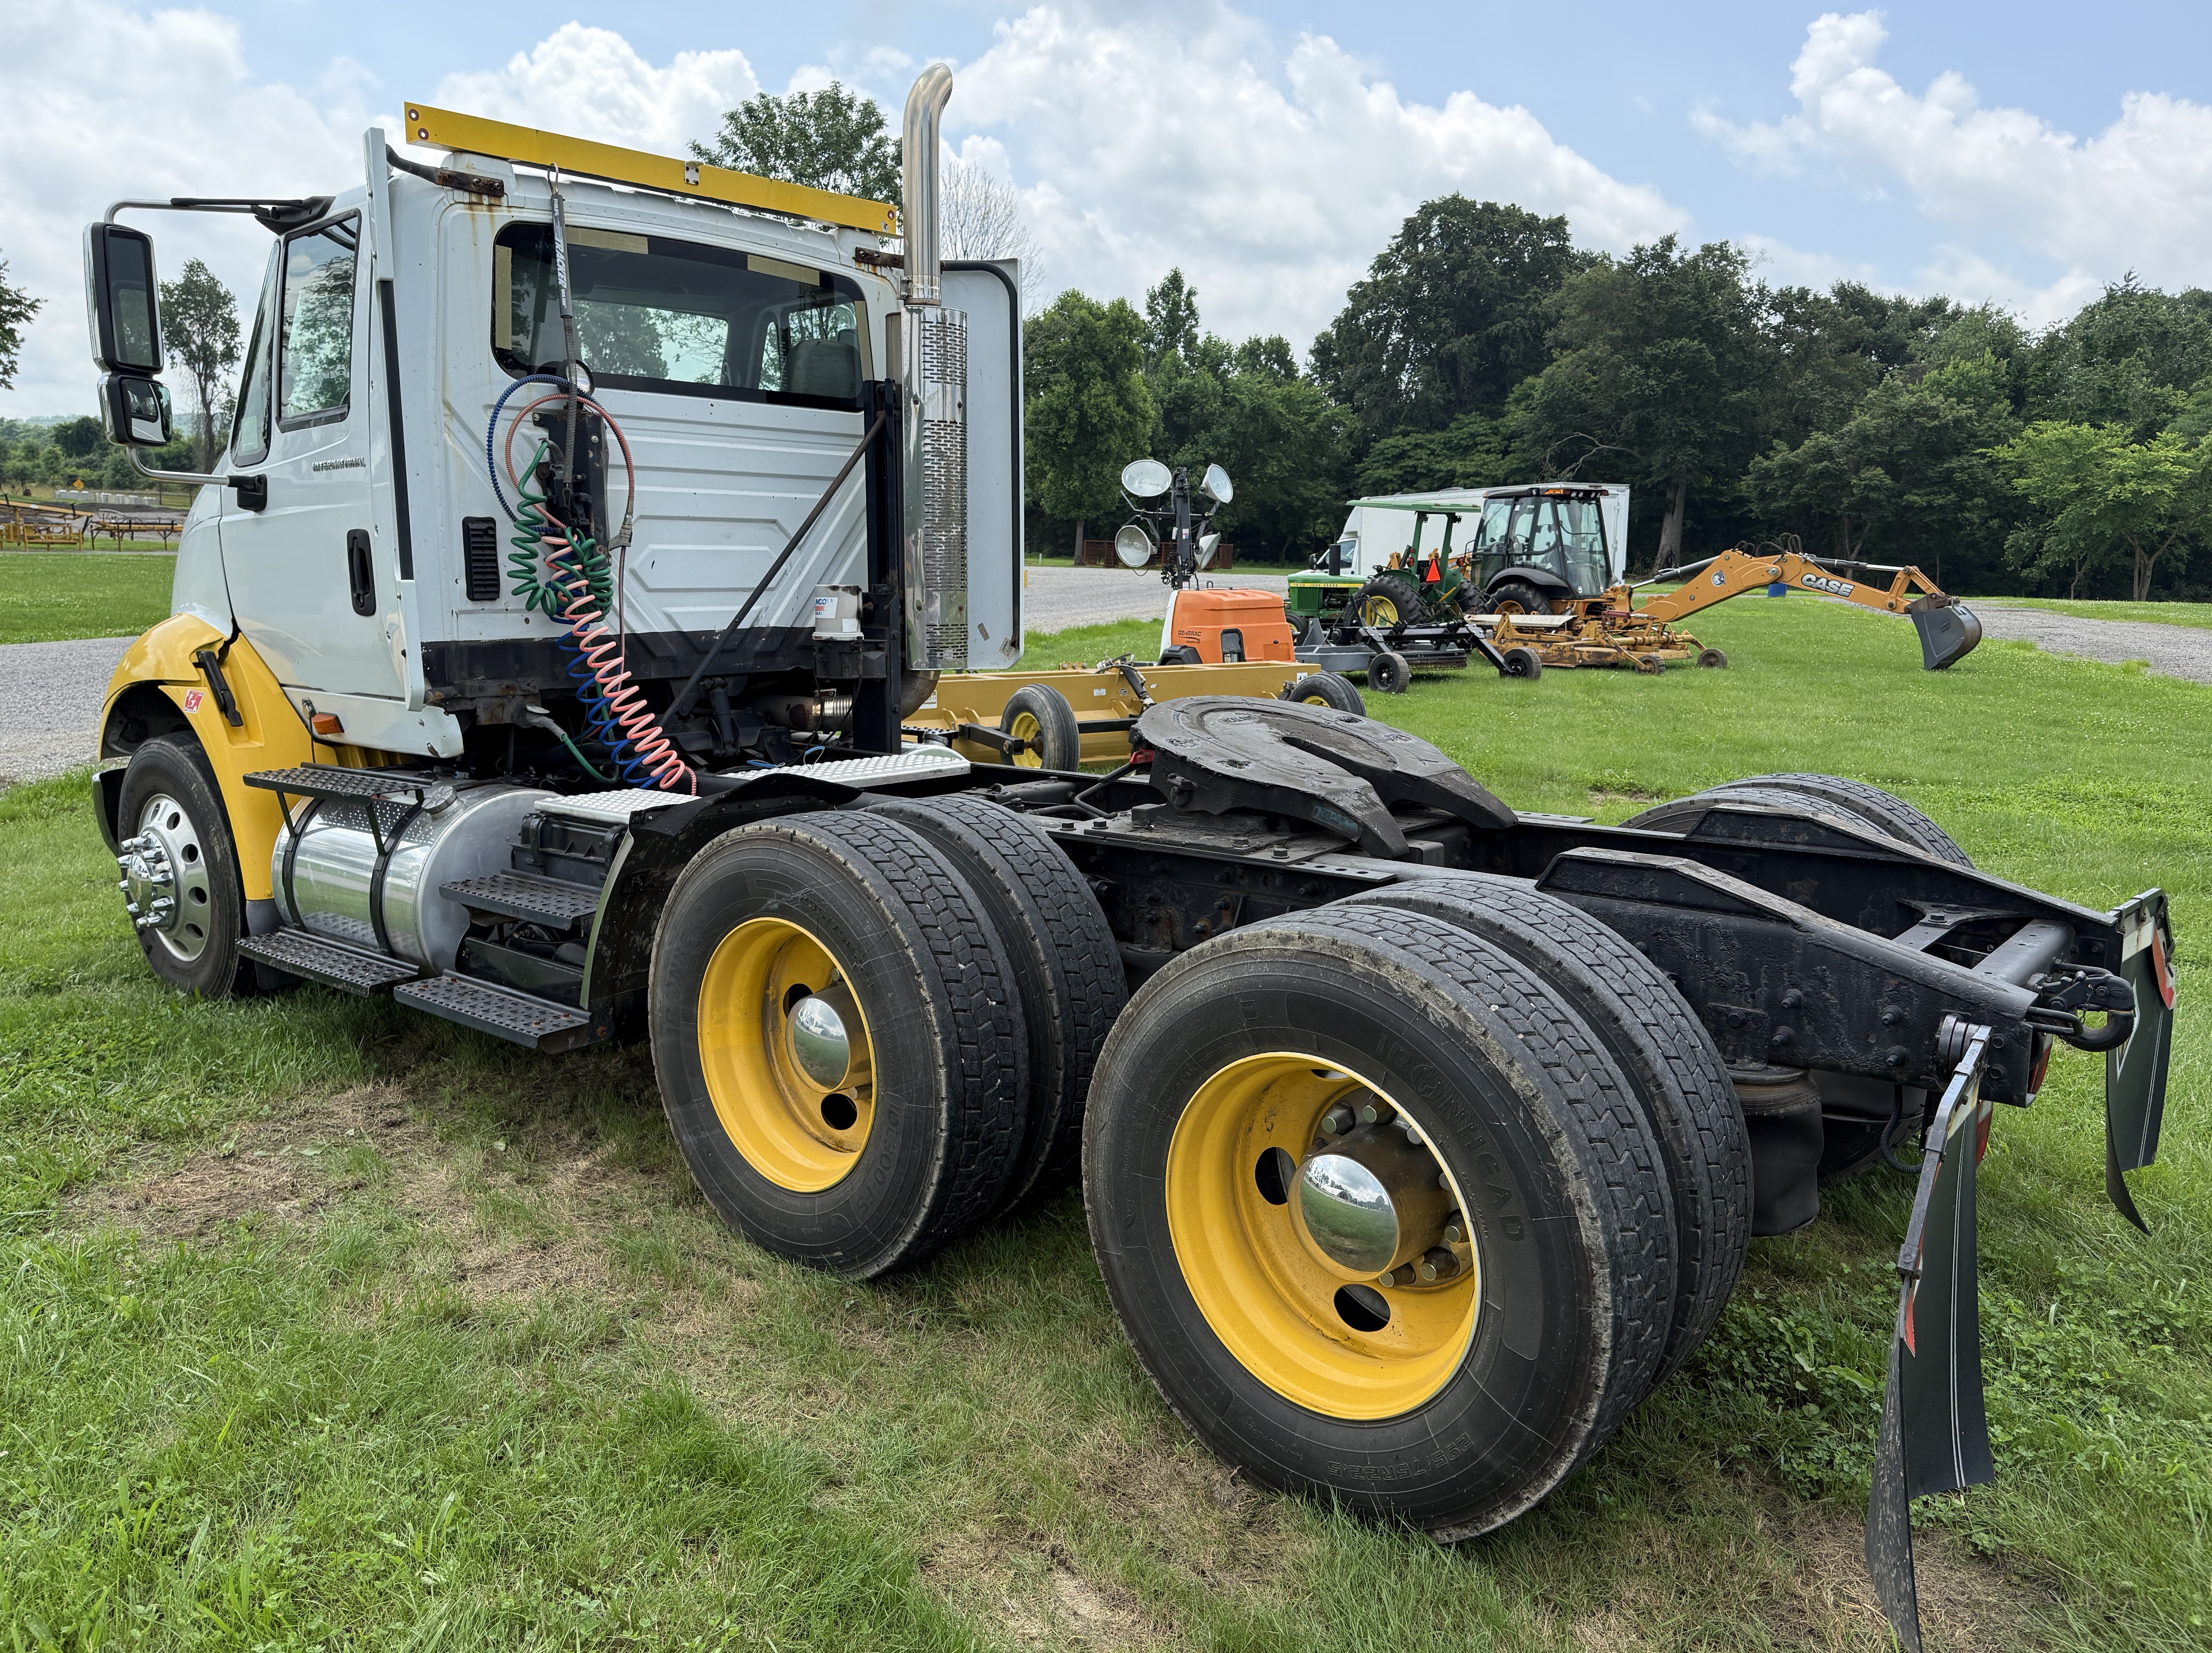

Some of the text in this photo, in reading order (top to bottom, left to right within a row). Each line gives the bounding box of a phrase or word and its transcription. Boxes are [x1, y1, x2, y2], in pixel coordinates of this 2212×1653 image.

[554, 237, 567, 288] TRACKER
[1801, 573, 1854, 597] CASE
[666, 904, 707, 1032] IRONHEAD
[799, 893, 878, 998] 295/75R22.5
[855, 1101, 900, 1218] IDL300-FS
[1327, 1432, 1474, 1481] 295/75R22.5
